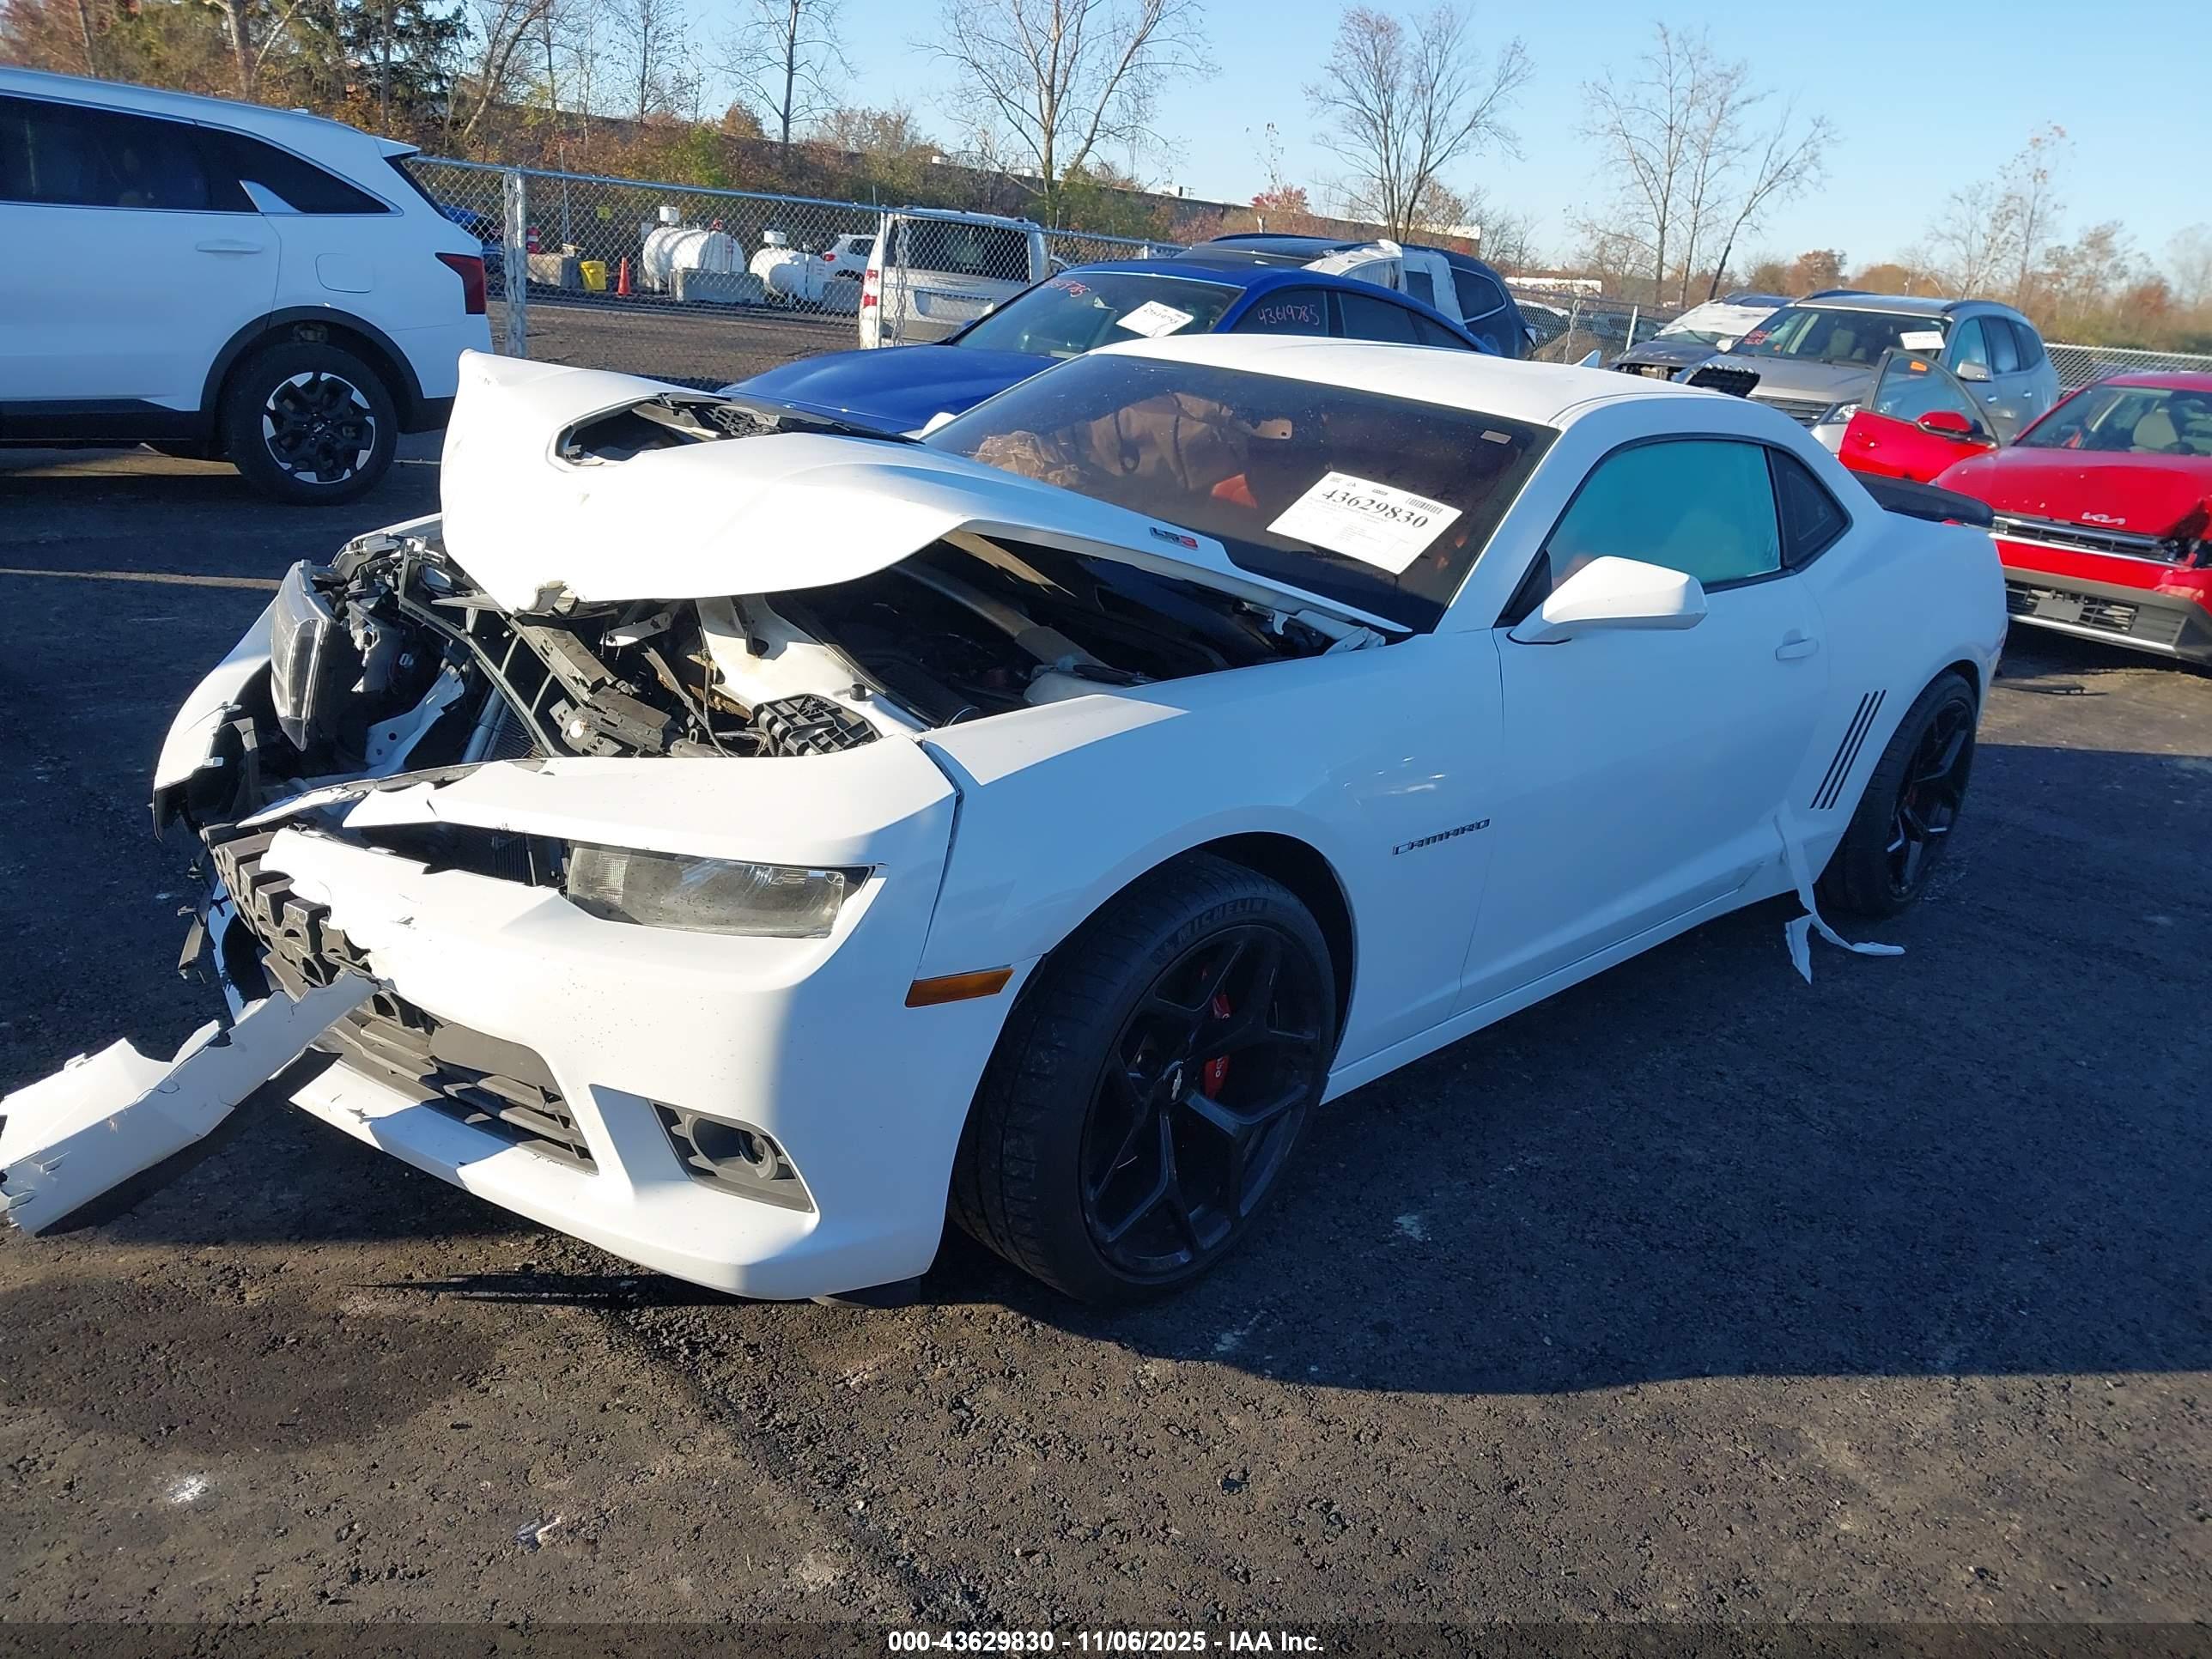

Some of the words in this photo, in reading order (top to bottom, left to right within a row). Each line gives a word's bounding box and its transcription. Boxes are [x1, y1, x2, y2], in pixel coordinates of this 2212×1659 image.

[1257, 304, 1320, 325] 43619785
[1322, 488, 1429, 529] 43629830
[1392, 818, 1491, 855] CAMARO
[1176, 897, 1269, 943] MICHELIN
